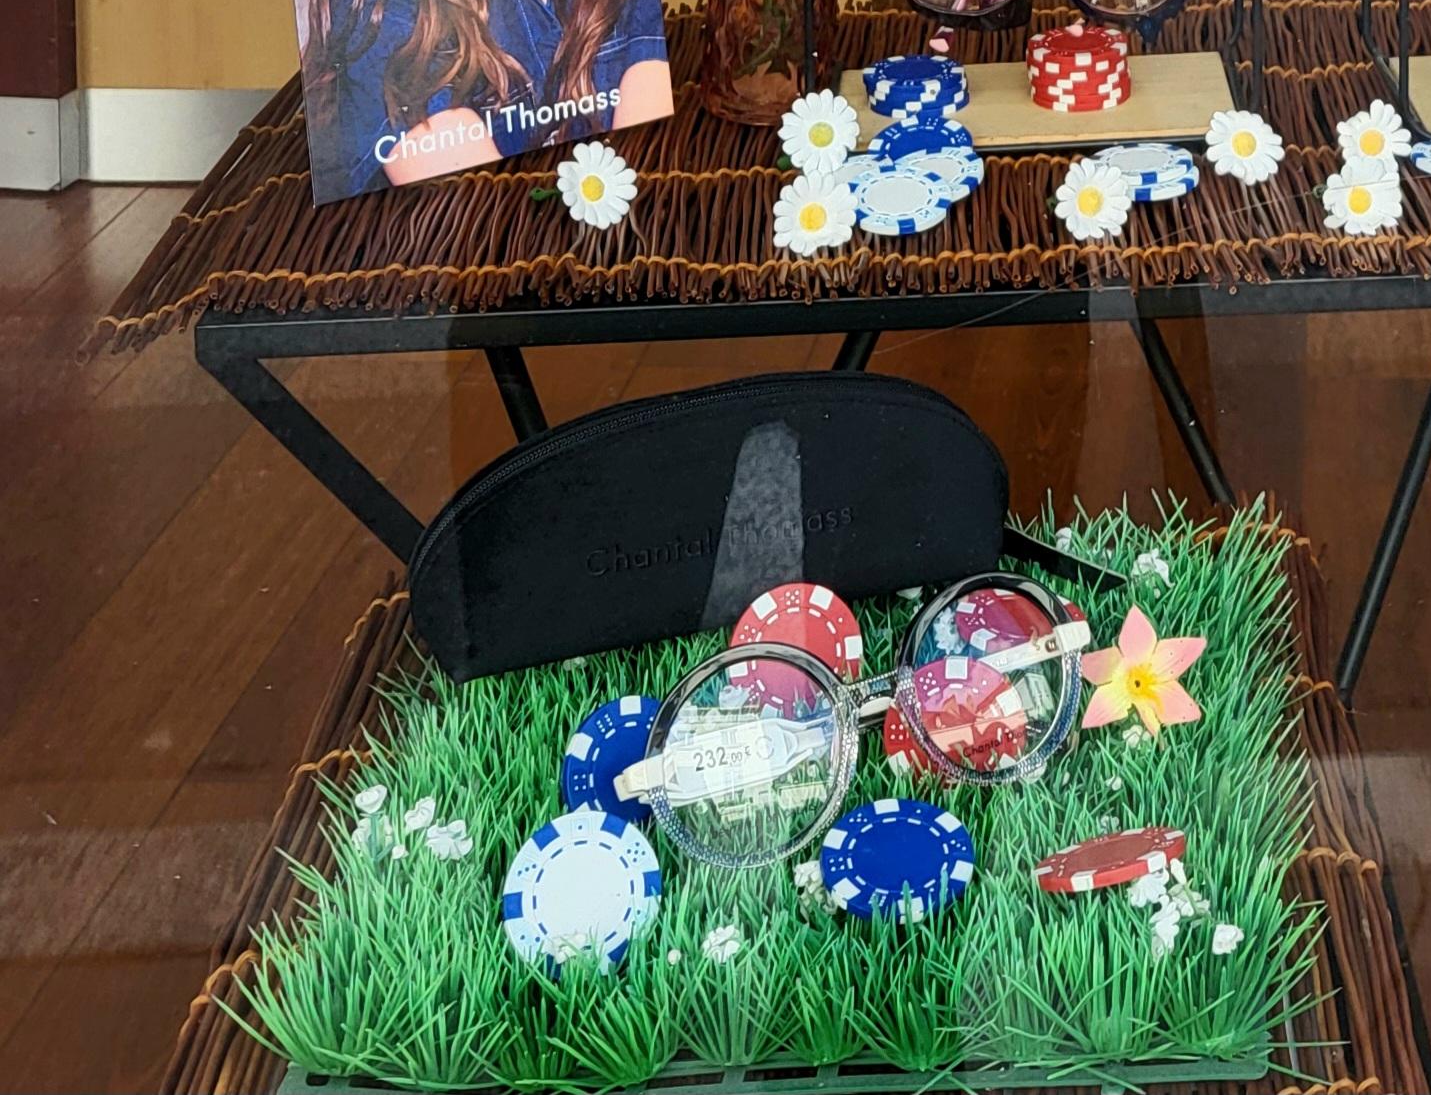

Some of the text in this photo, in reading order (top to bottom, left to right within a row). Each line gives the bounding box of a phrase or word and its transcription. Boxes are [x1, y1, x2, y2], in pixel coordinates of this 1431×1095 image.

[373, 87, 622, 164] Chantal Thomass
[586, 526, 714, 576] Chantal
